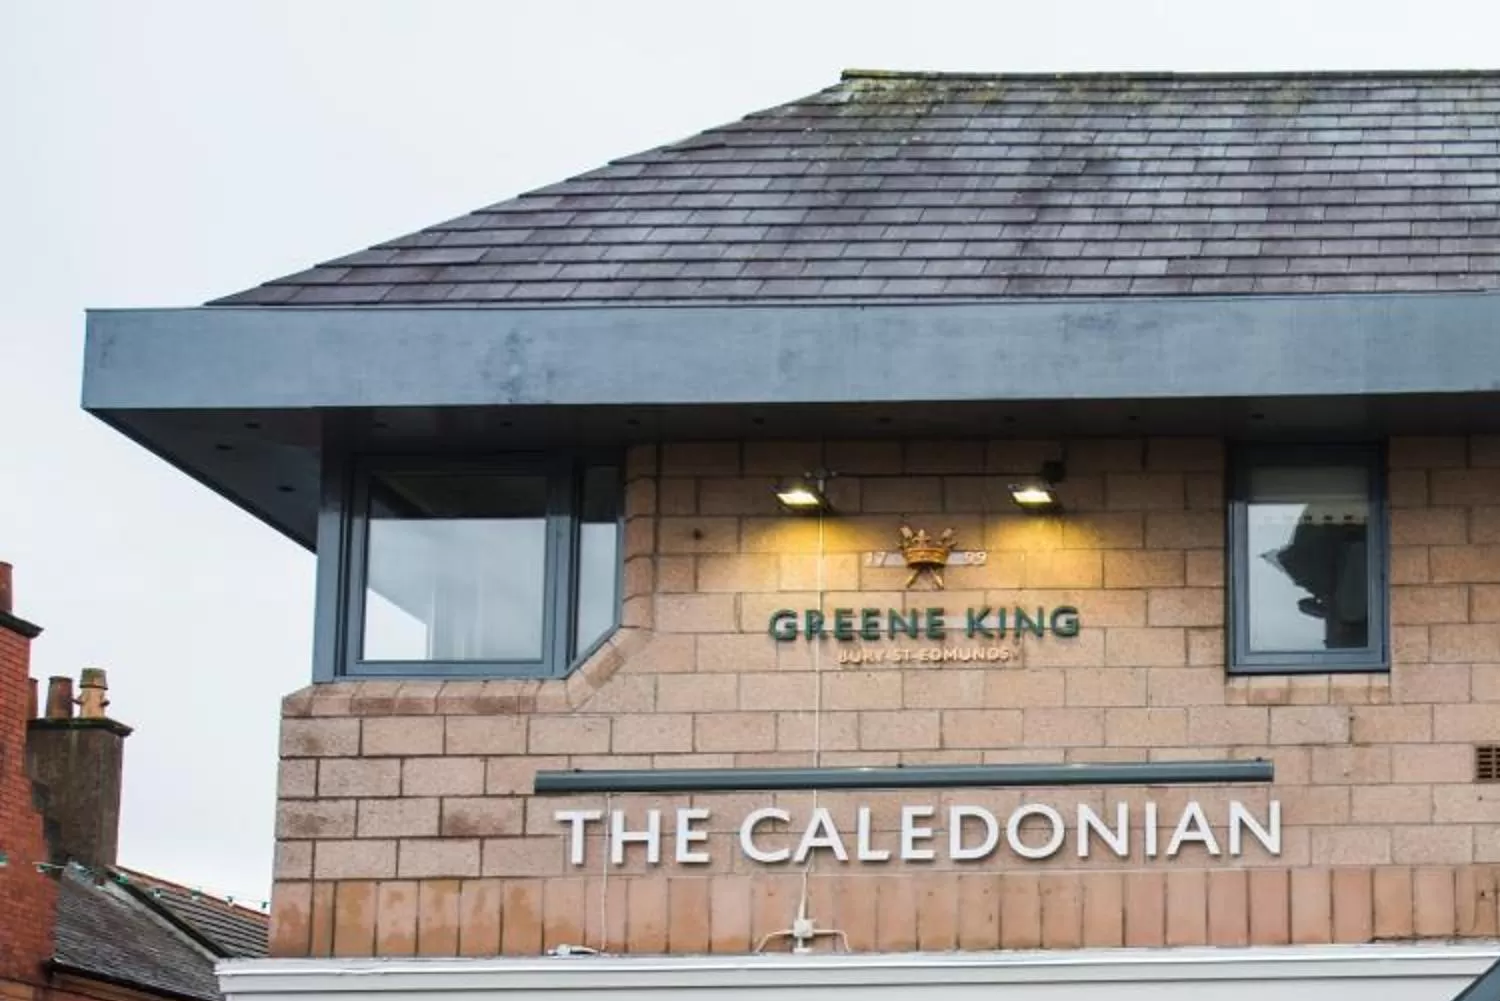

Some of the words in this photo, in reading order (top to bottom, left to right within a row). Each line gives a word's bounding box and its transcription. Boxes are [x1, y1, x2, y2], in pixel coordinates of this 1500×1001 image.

[768, 606, 946, 641] GREENE
[966, 604, 1081, 640] KING
[555, 808, 712, 867] THE
[739, 799, 1284, 864] CALEDONIAN
